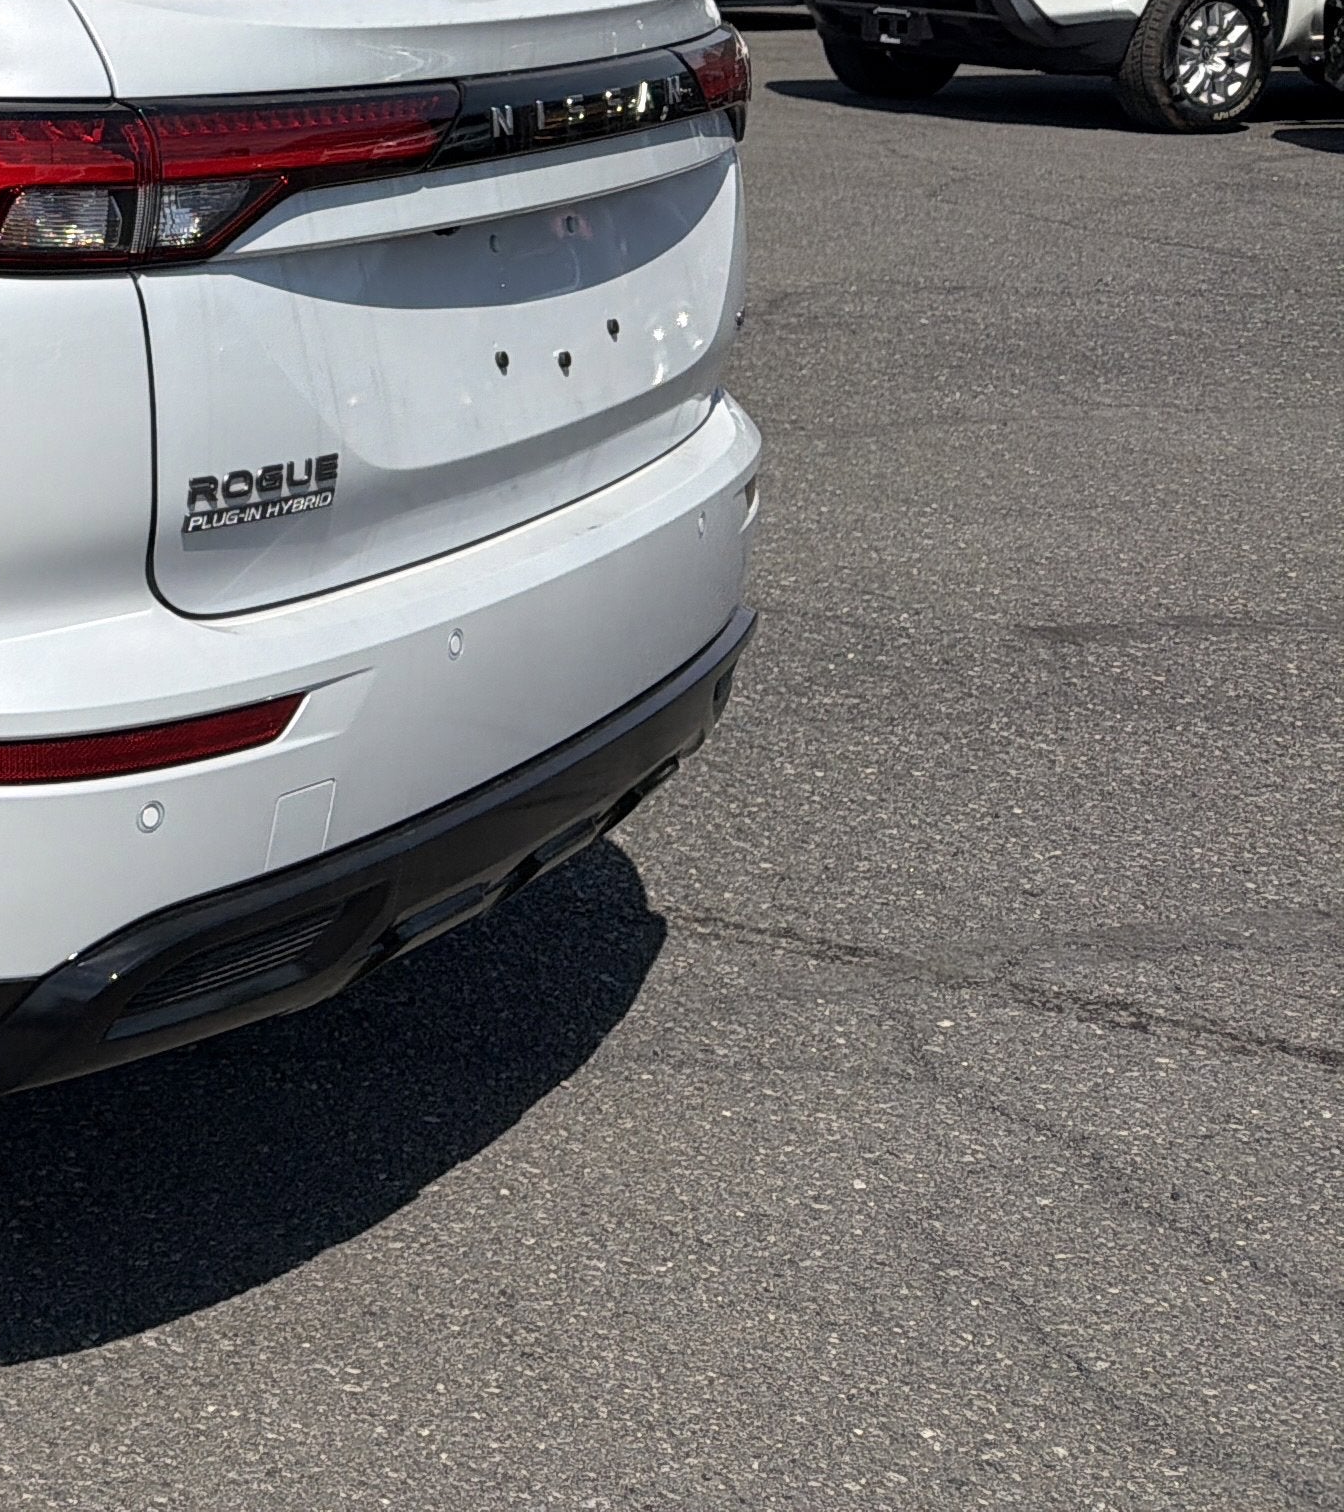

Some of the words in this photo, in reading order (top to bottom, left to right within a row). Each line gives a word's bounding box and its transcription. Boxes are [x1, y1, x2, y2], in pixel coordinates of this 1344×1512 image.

[187, 452, 339, 508] ROGUE
[187, 505, 262, 532] PLUG-IN
[265, 491, 333, 518] HYBRID
